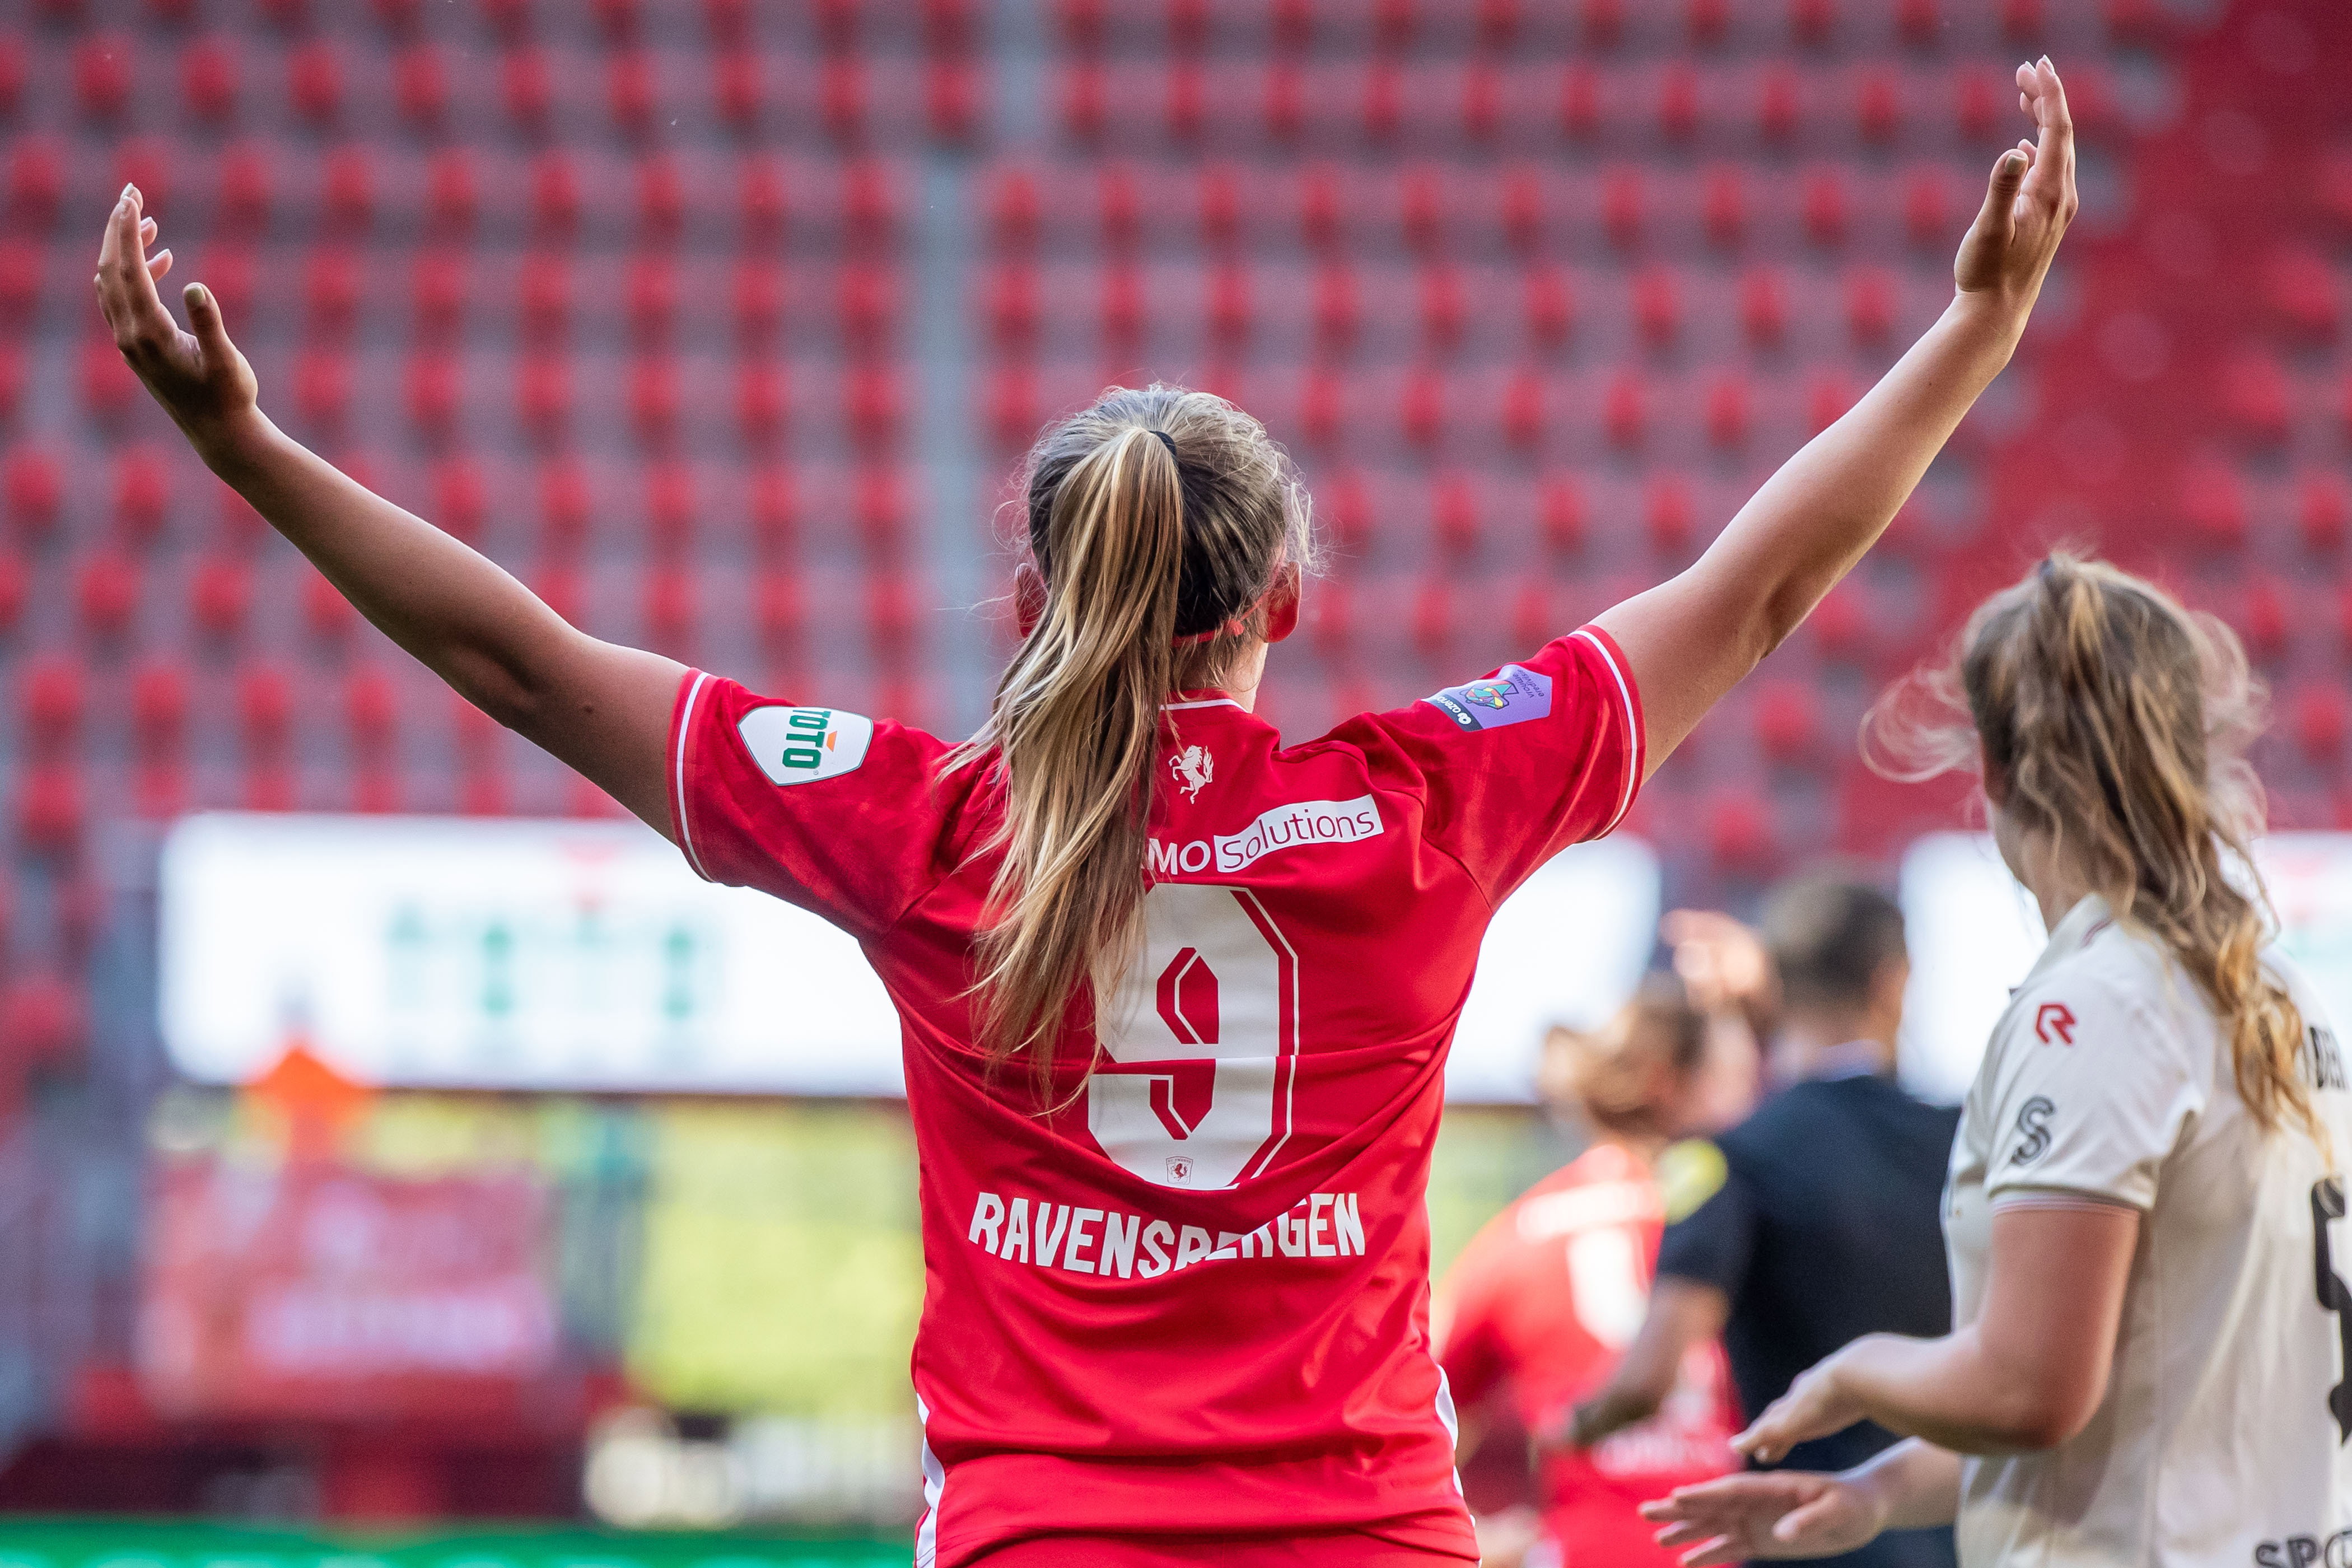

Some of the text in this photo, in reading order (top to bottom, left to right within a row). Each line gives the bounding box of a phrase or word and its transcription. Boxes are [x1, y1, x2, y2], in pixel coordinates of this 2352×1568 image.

[782, 710, 832, 769] TOTO
[1140, 809, 1375, 875] MO Solutions
[1088, 883, 1299, 1189] 9
[2035, 1004, 2076, 1046] R
[2009, 1096, 2056, 1166] S
